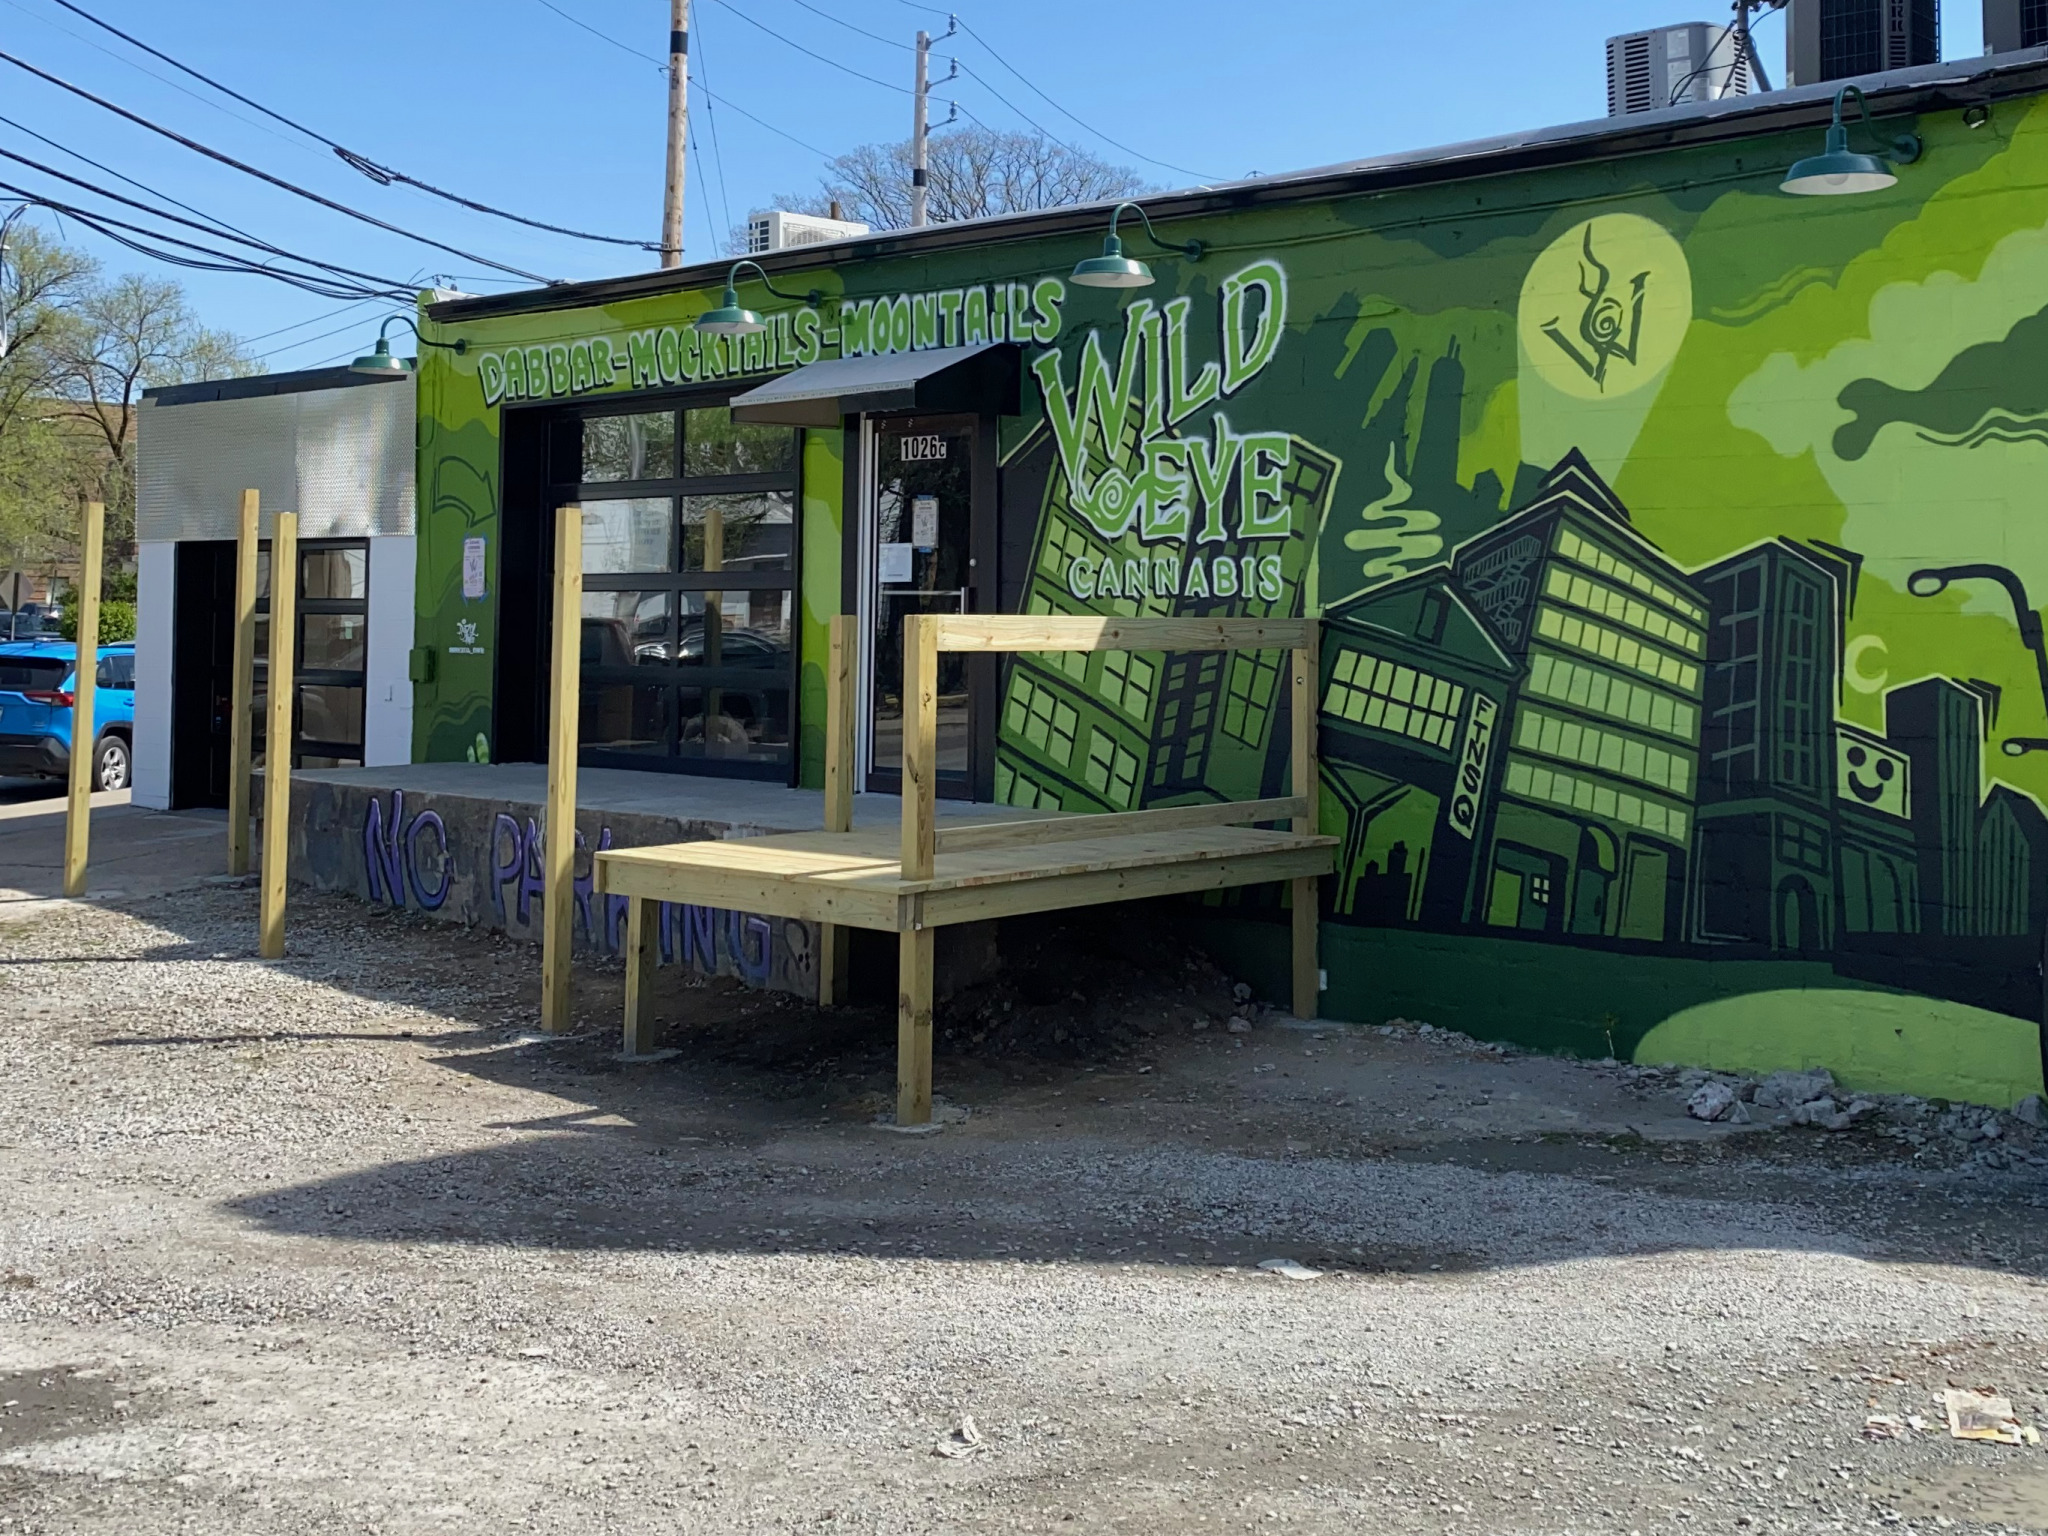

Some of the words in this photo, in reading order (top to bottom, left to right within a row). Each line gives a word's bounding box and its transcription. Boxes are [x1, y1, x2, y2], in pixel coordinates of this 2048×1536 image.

[1891, 0, 1904, 32] RK
[1032, 261, 1288, 495] WILD
[1138, 412, 1290, 543] EYE
[1068, 555, 1283, 602] CANNABIS
[364, 789, 452, 911] NO
